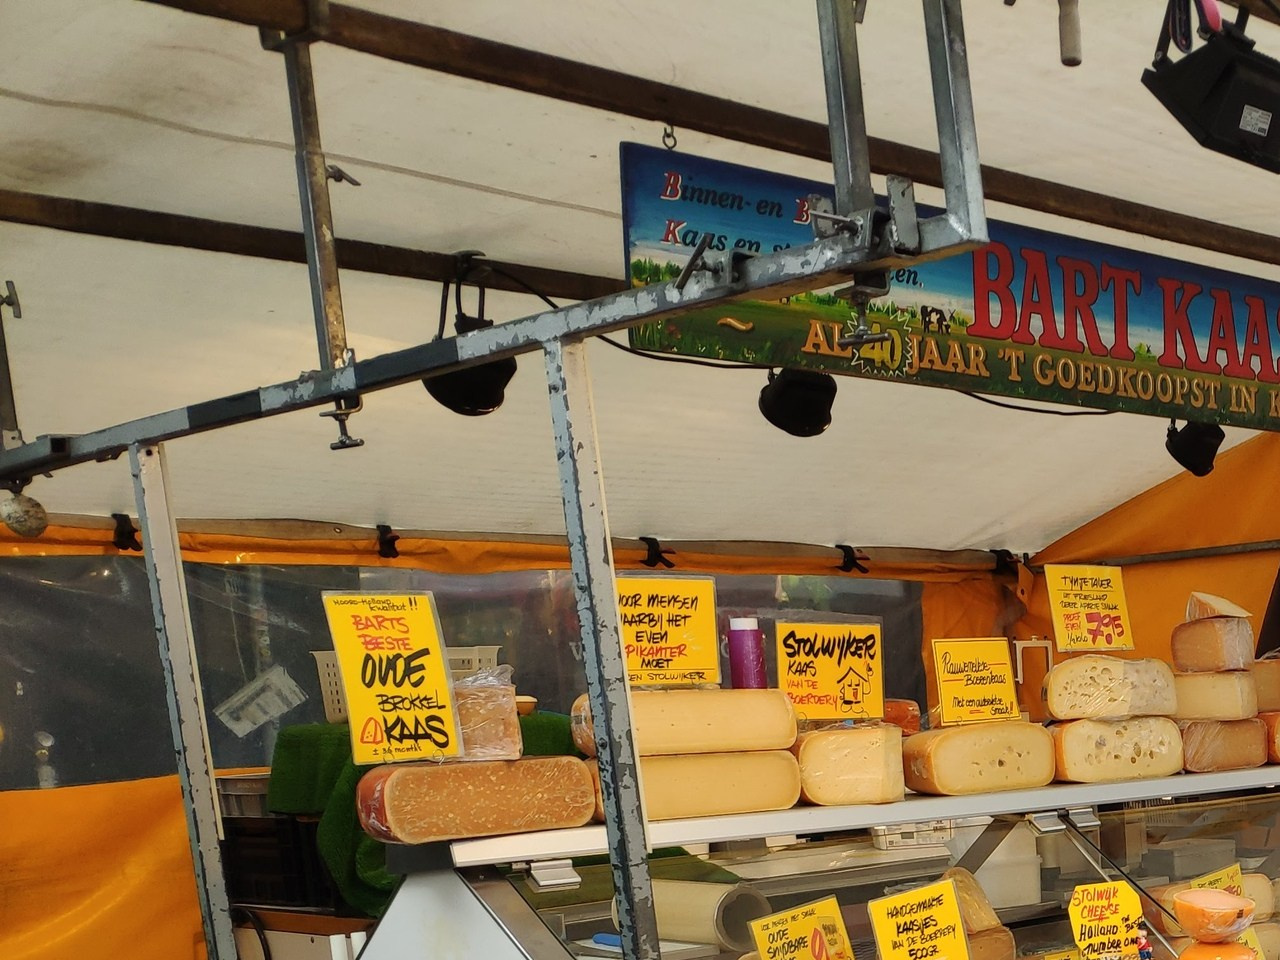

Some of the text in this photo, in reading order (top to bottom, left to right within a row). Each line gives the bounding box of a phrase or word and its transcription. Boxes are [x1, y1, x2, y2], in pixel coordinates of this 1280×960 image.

[660, 169, 751, 211] Binnen-
[756, 199, 783, 218] en
[966, 240, 1142, 362] BART
[801, 319, 853, 358] AL
[907, 333, 990, 378] JAAR
[1032, 353, 1222, 411] GOEDKOOPST
[1229, 382, 1258, 415] IN
[647, 593, 698, 612] MENSEN
[351, 614, 409, 633] BARTS
[620, 612, 692, 631] AARBIJ HET
[358, 634, 413, 651] BESTE
[635, 630, 668, 644] EVEN
[624, 643, 688, 659] PIKANTER
[362, 648, 431, 689] OUDE
[640, 657, 674, 669] MOET
[787, 660, 817, 677] KAAS
[787, 679, 818, 689] VAN DE
[375, 689, 447, 713] BROKKEL
[382, 715, 450, 749] KAAS
[1080, 903, 1120, 919] CHEESE
[768, 928, 789, 945] OUDE
[891, 939, 904, 950] VAN
[906, 936, 917, 947] DE
